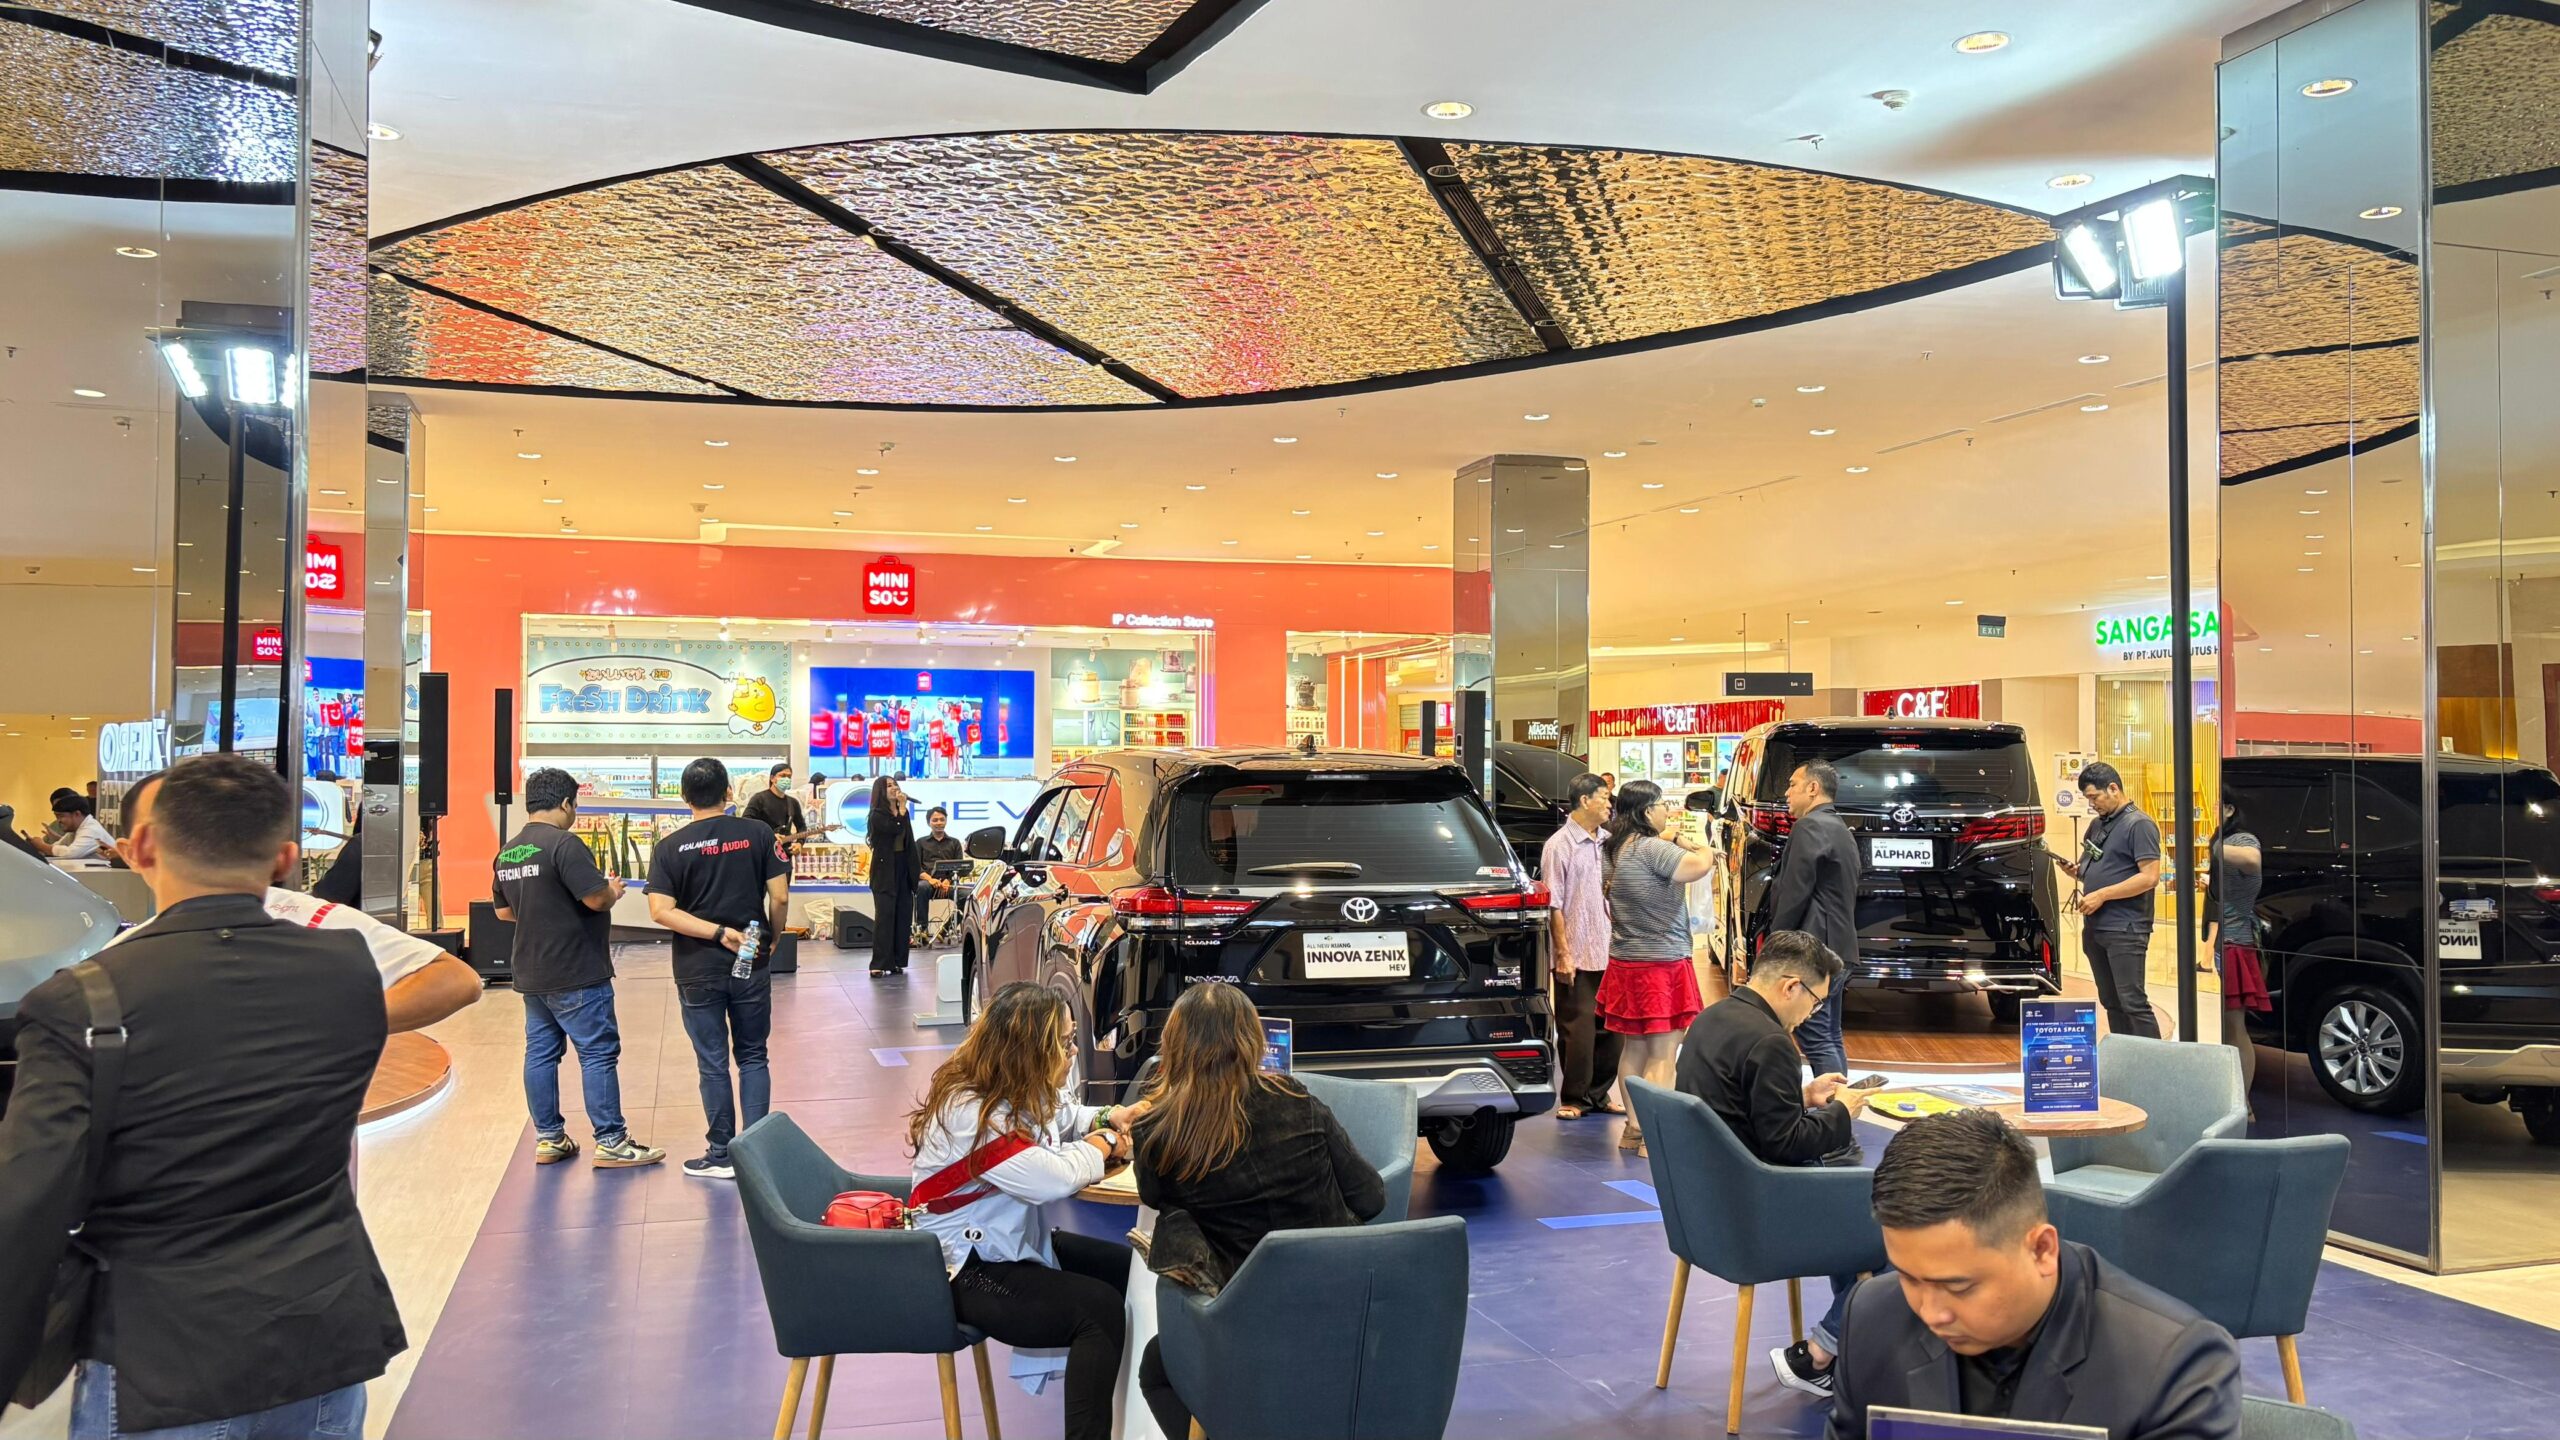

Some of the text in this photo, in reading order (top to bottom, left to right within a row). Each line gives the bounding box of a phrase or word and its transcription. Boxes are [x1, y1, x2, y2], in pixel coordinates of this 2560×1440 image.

[869, 572, 908, 588] MINI
[1112, 613, 1214, 628] IP Collection Store
[1983, 627, 2000, 635] EXIT
[257, 637, 281, 646] MIN
[2124, 652, 2132, 660] BY
[1896, 691, 1944, 718] C&F
[1665, 707, 1696, 732] C&F
[871, 729, 889, 737] MINI
[909, 801, 1028, 820] HEV
[702, 840, 750, 855] PRO AUDIO
[1874, 850, 1931, 859] ALPHARD
[1307, 950, 1406, 963] INNOVA ZENIX
